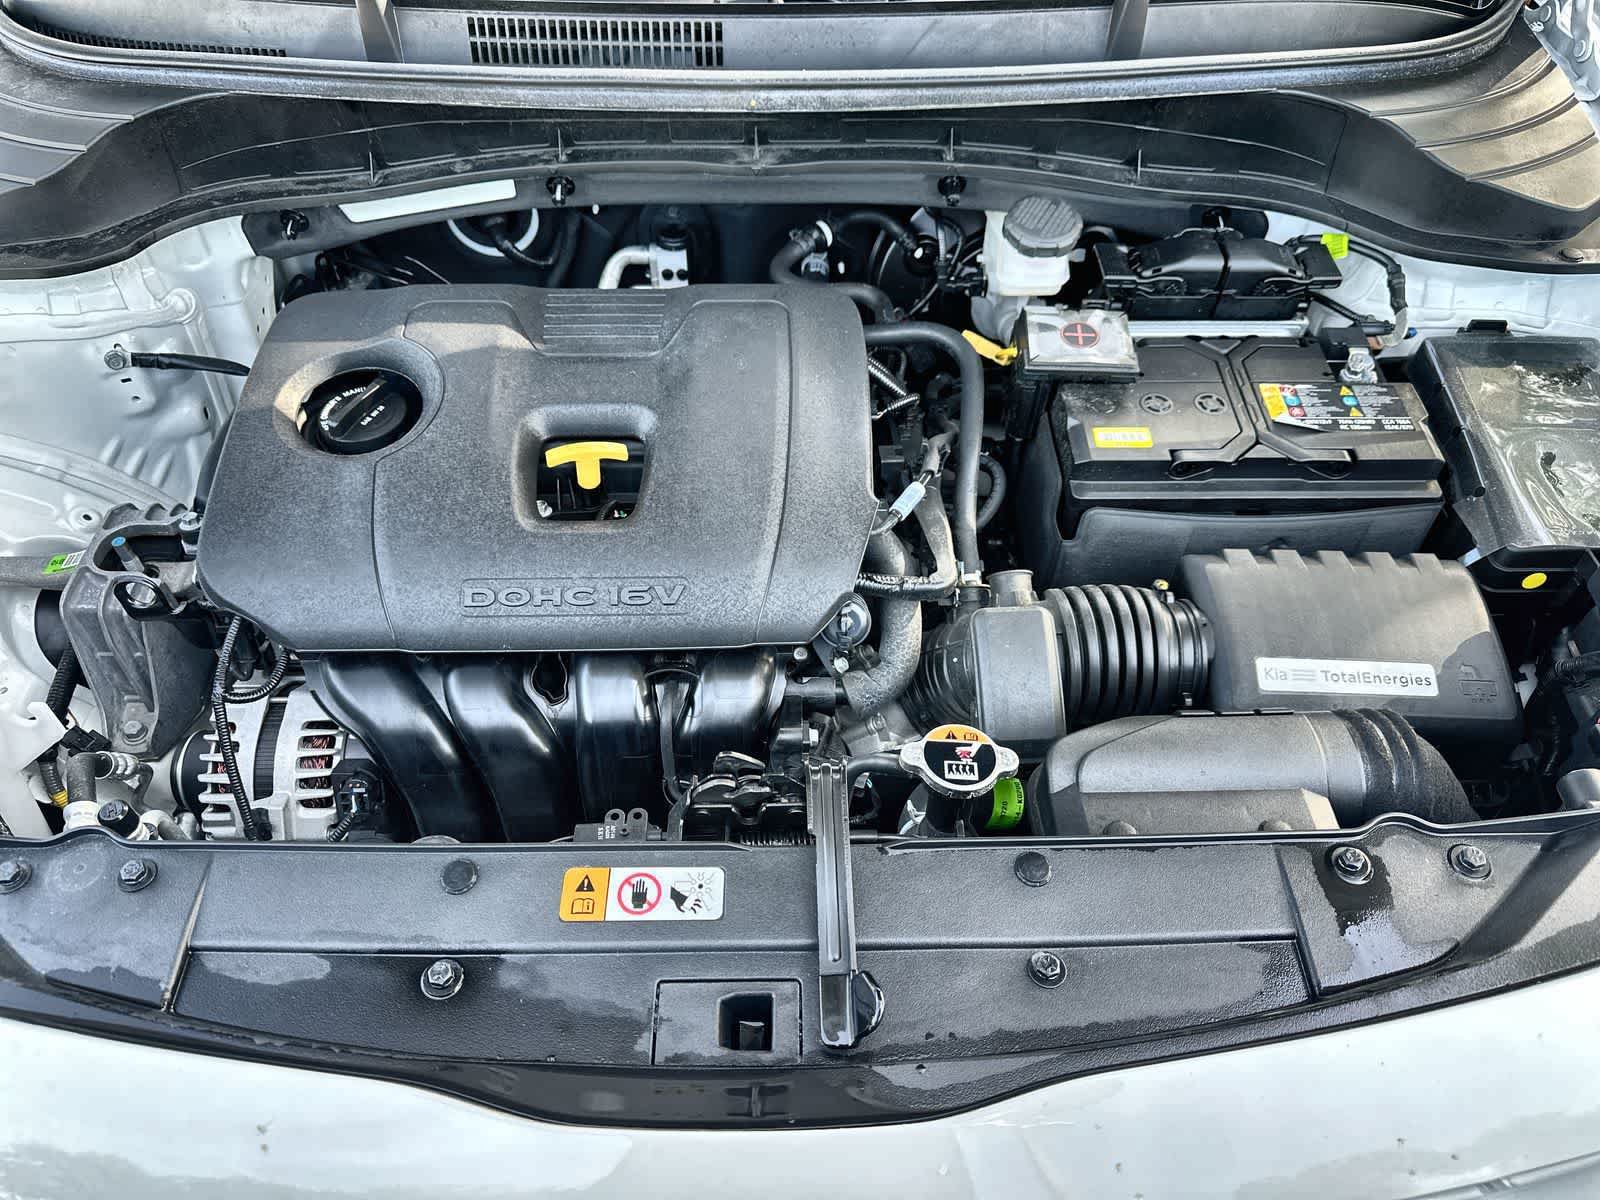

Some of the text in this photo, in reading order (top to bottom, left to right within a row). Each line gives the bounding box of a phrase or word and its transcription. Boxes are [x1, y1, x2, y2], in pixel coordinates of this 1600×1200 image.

[463, 584, 686, 608] DOHC 16V
[1263, 667, 1432, 688] Kia TotalEnergies
